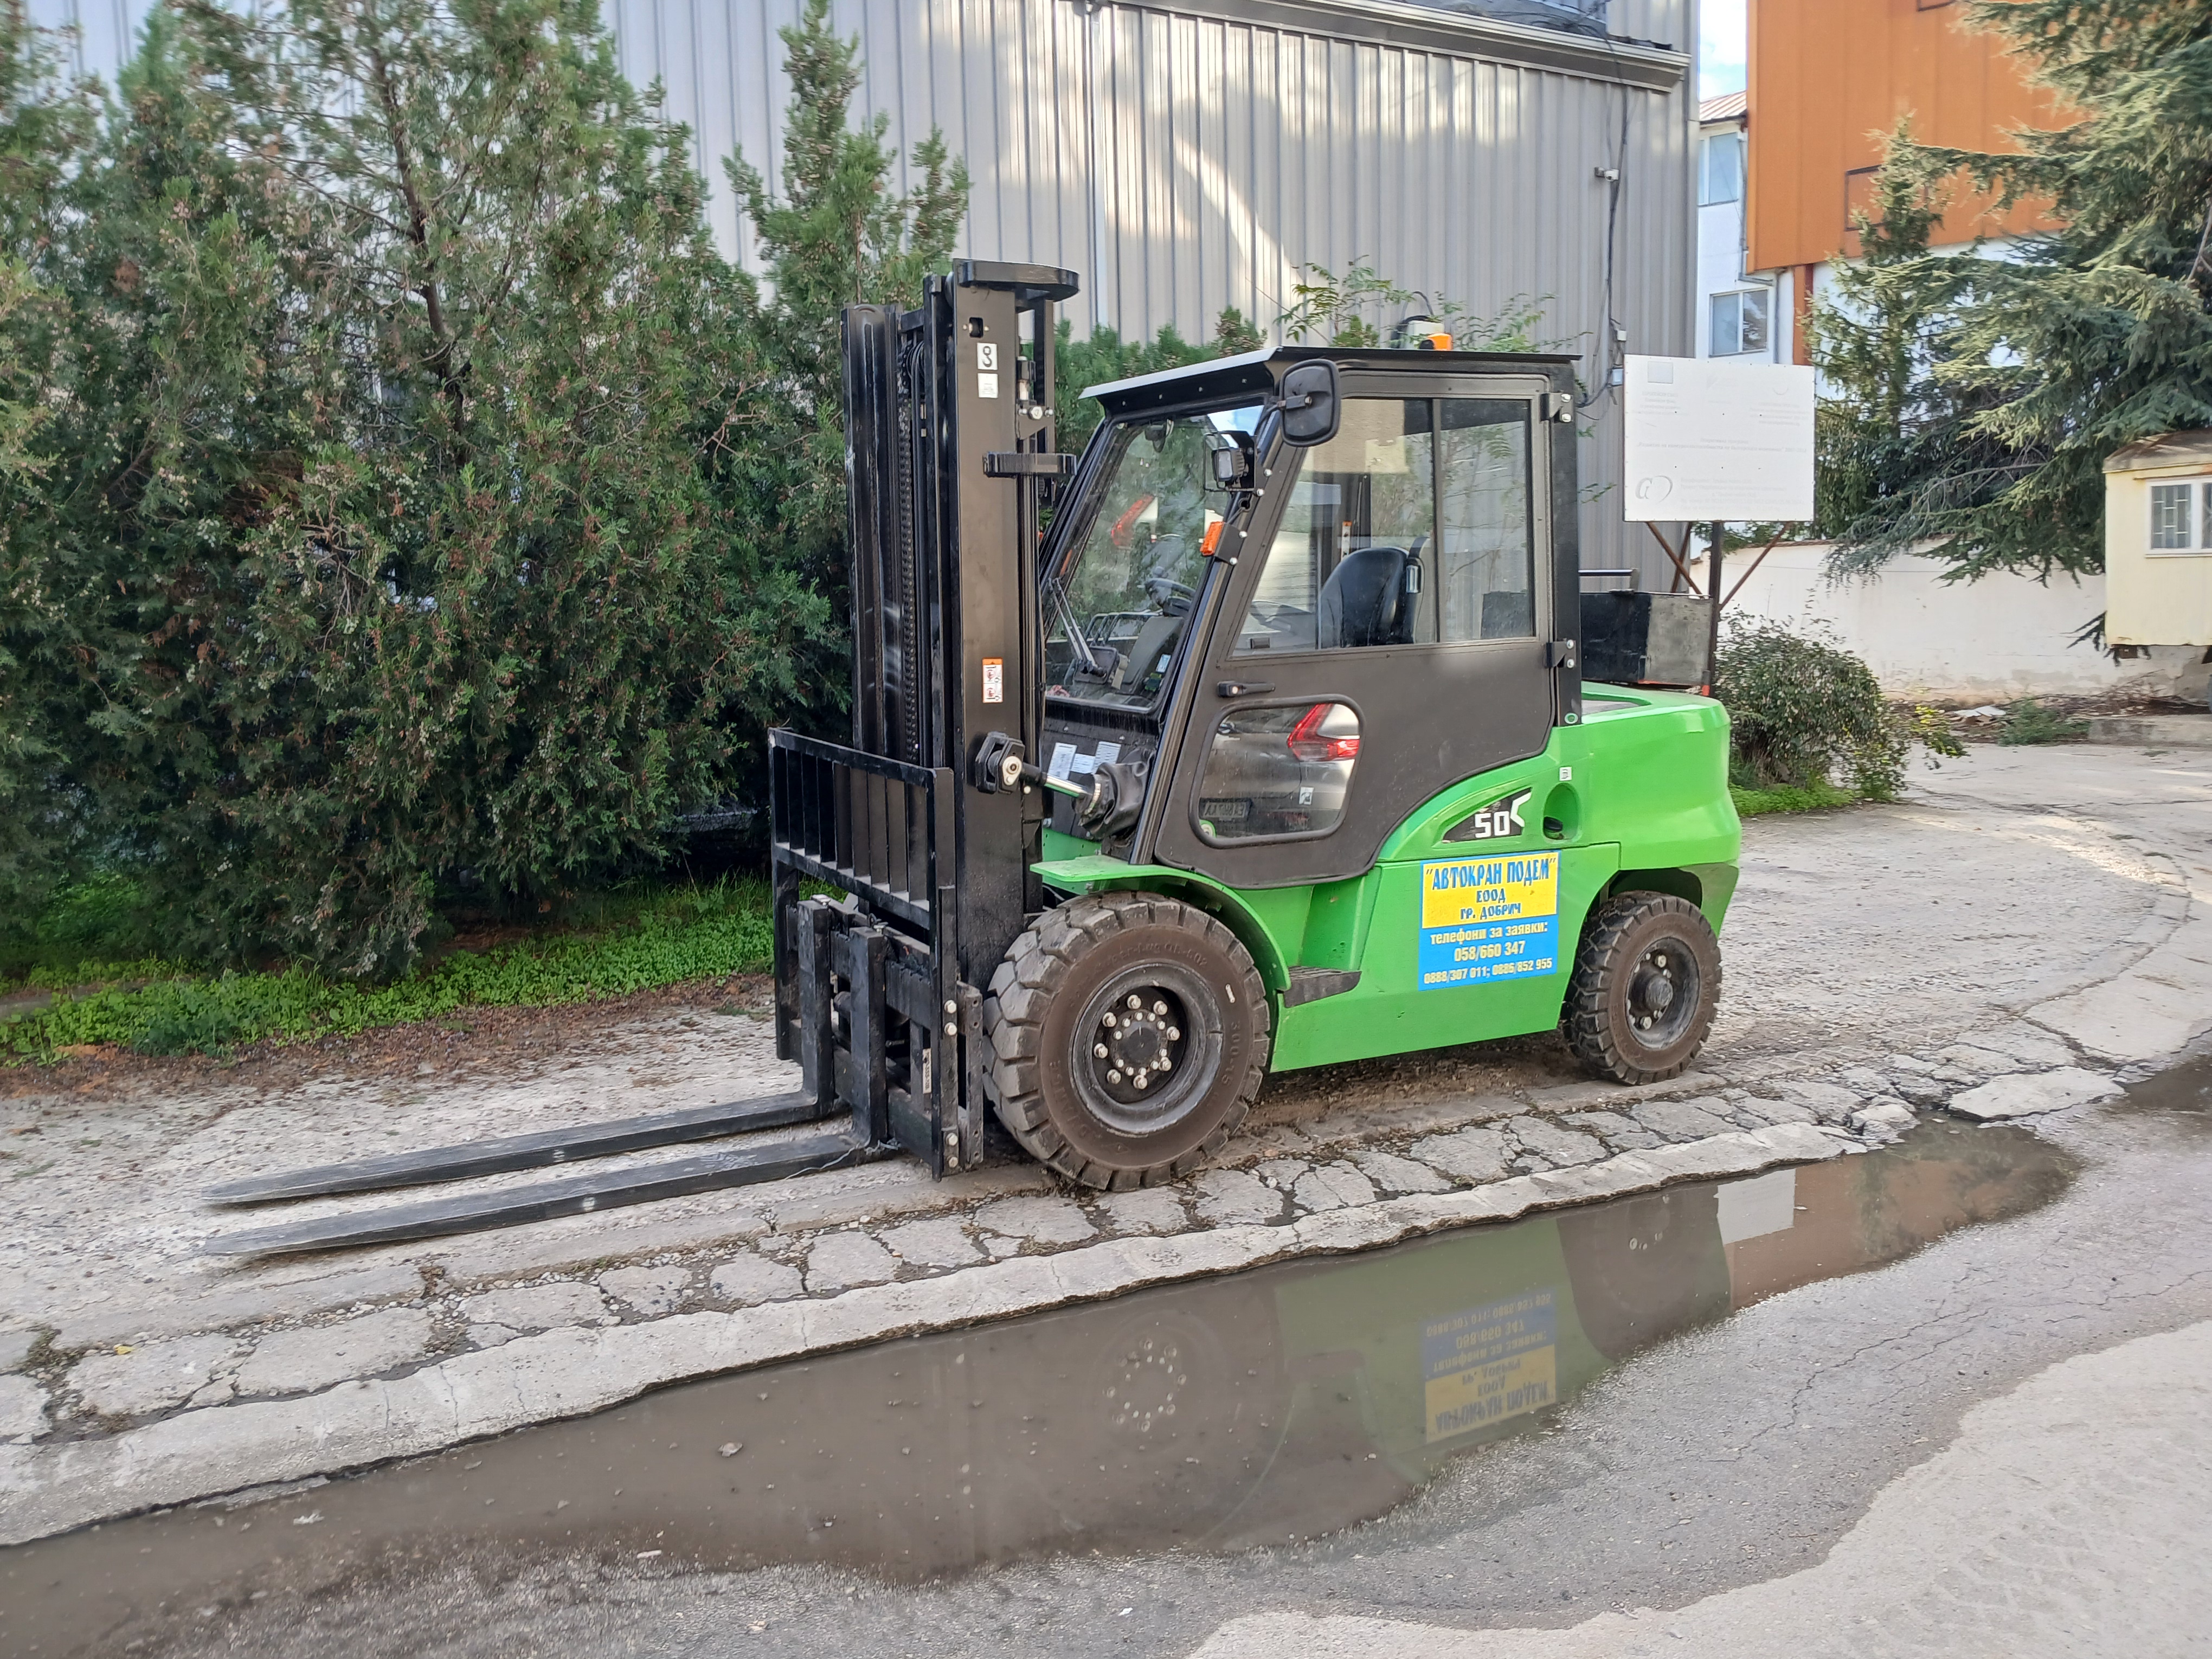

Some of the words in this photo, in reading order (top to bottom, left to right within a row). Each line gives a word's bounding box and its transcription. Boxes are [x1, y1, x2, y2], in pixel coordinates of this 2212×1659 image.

[1426, 862, 1502, 890] "АВТОКРАН
[1507, 858, 1556, 886] ПОДЕМ"
[1476, 888, 1506, 904] ЕООД
[1461, 908, 1476, 919] ГР.
[1480, 903, 1521, 920] ДОБРИЧ
[1430, 928, 1487, 944] телефони
[1489, 927, 1503, 938] за
[1505, 921, 1548, 936] заявки:
[1454, 944, 1502, 962] 058/660
[1504, 940, 1526, 956] 347
[1536, 957, 1553, 969] 955
